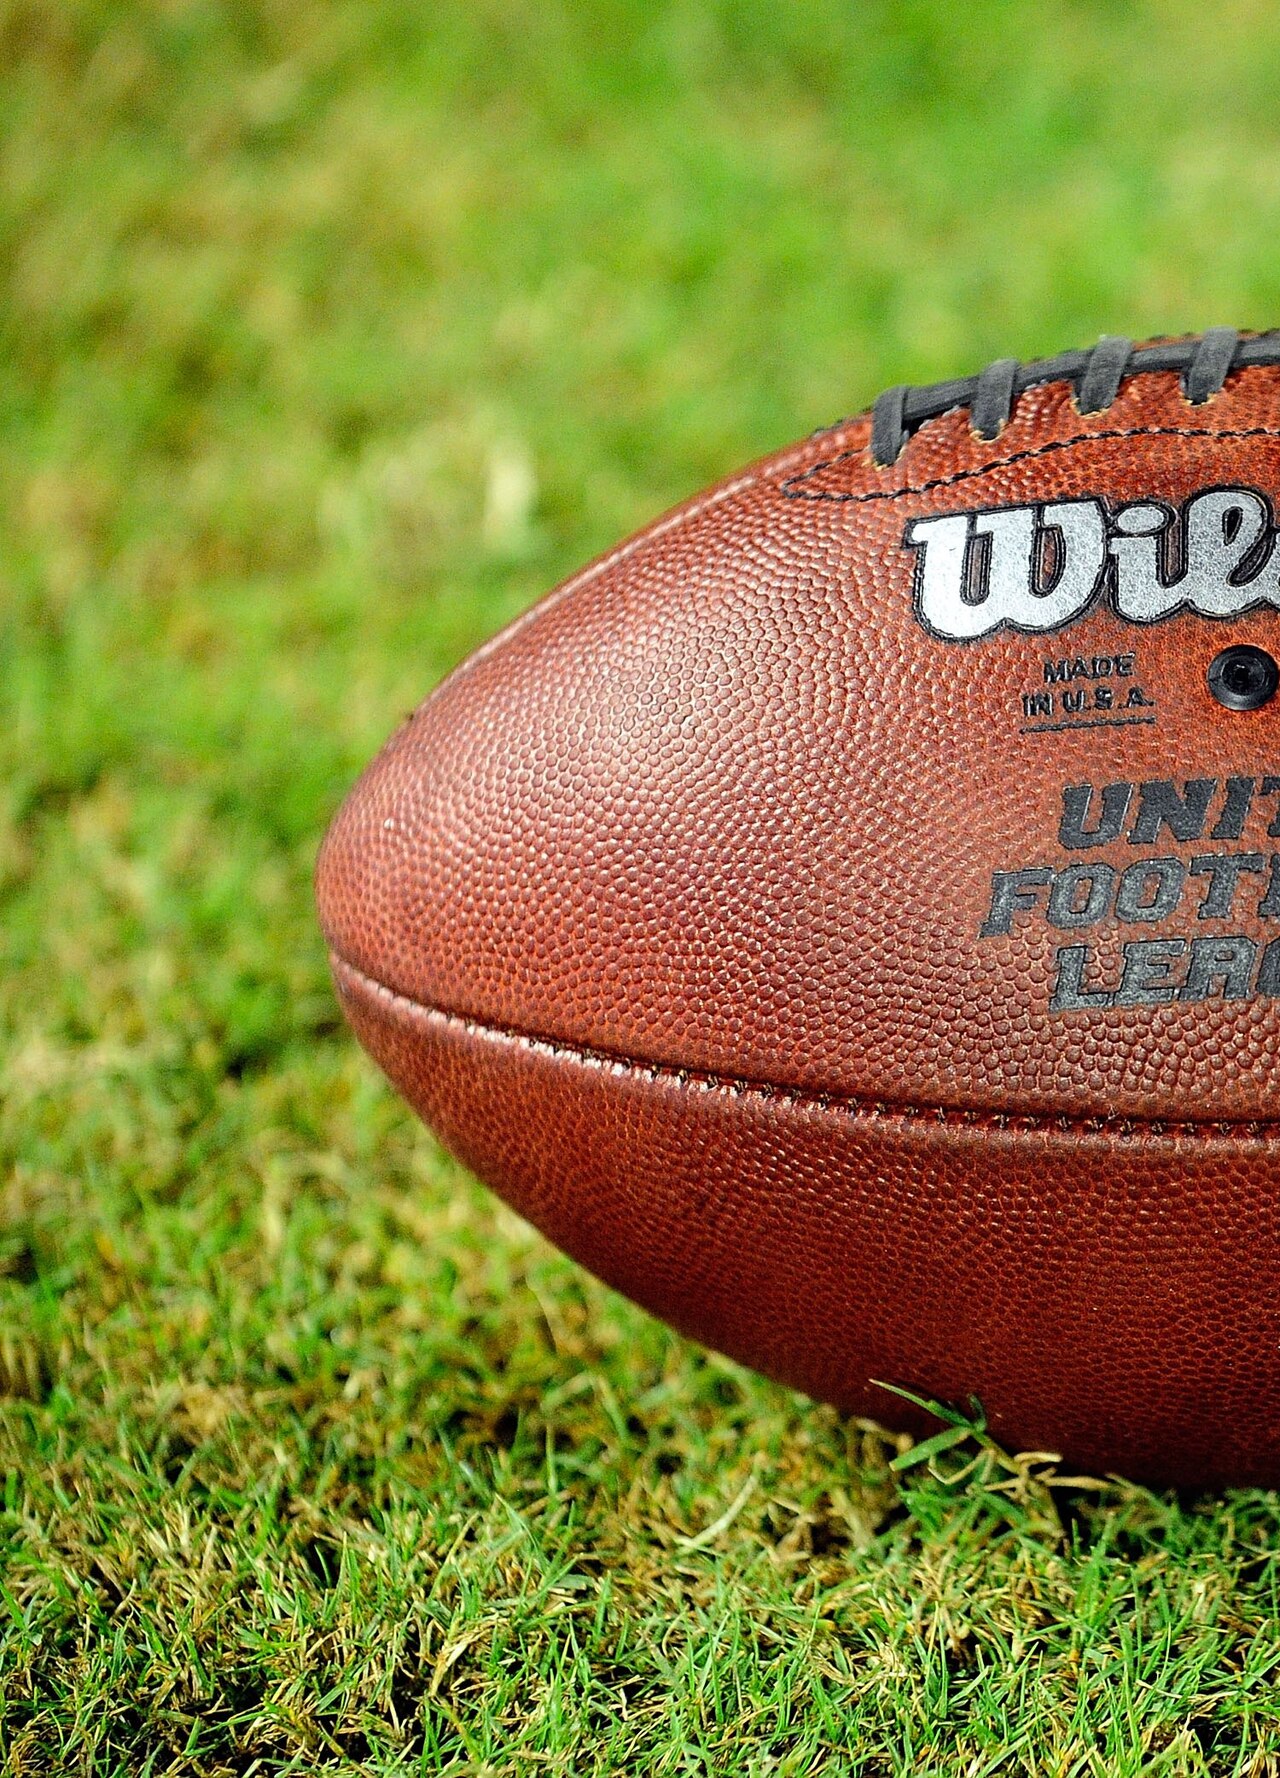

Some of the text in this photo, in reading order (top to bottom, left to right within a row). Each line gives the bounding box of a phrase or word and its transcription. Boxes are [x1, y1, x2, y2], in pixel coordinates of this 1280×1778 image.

[1043, 651, 1136, 683] MADE
[1021, 684, 1155, 717] IN U.S.A.
